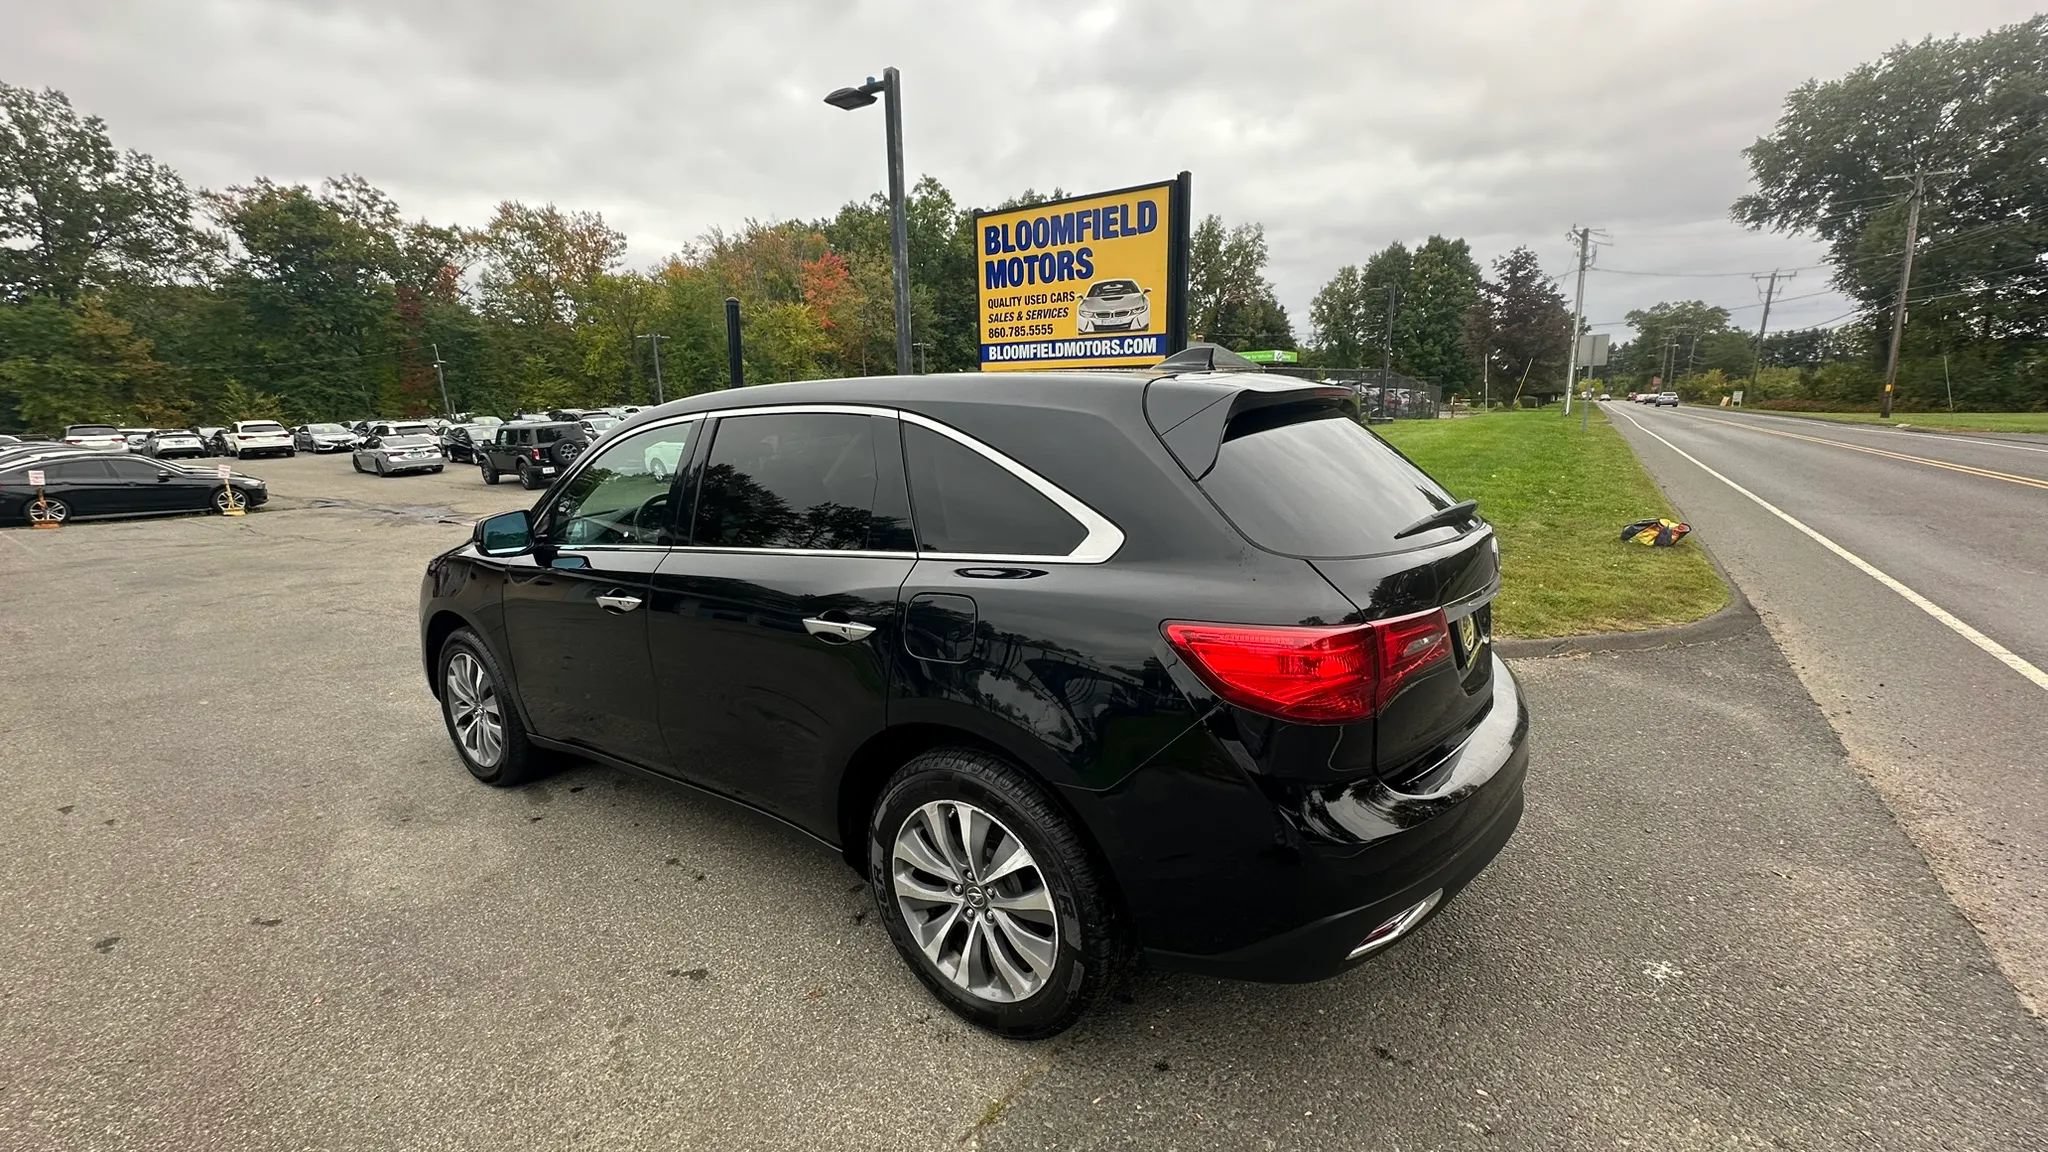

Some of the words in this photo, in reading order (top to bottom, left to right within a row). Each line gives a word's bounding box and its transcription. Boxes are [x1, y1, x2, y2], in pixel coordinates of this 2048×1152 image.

[984, 200, 1158, 256] BLOOMFIELD
[985, 247, 1094, 290] MOTORS
[988, 296, 1022, 309] QUALITY
[1024, 294, 1048, 305] USED
[1050, 291, 1075, 303] CARS
[988, 312, 1014, 323] SALES
[1016, 311, 1023, 322] &
[1025, 307, 1069, 320] SERVICES
[988, 324, 1053, 339] 860.785.5555
[988, 337, 1157, 361] BLOOMFIELDMOTORS.COM
